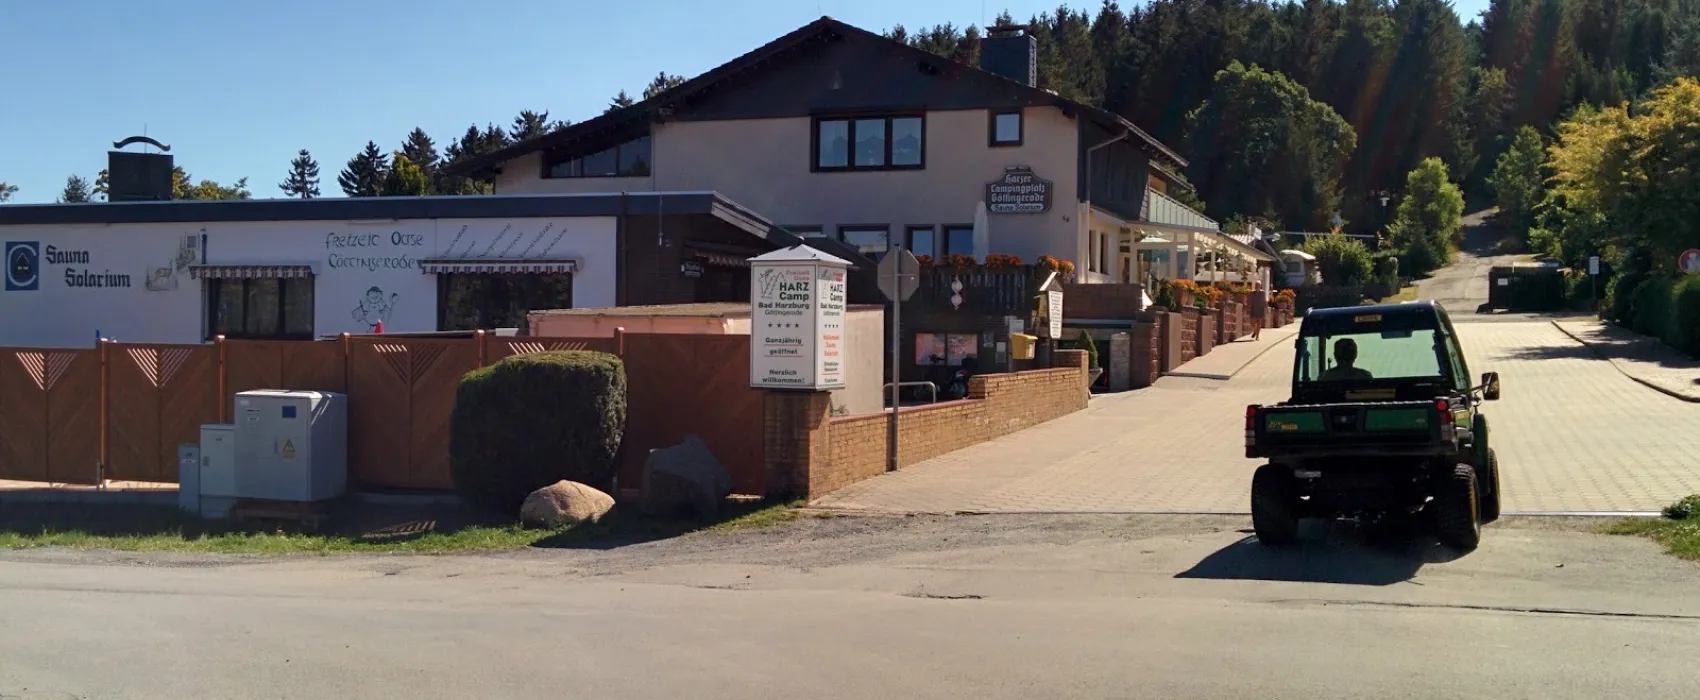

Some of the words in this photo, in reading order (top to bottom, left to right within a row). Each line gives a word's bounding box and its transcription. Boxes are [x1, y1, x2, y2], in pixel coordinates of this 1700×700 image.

[391, 231, 424, 246] Oase
[45, 244, 90, 265] Sauna
[64, 267, 131, 288] Solarium
[779, 282, 810, 291] HARZ
[779, 292, 810, 302] Camp
[775, 302, 810, 310] Harzburg
